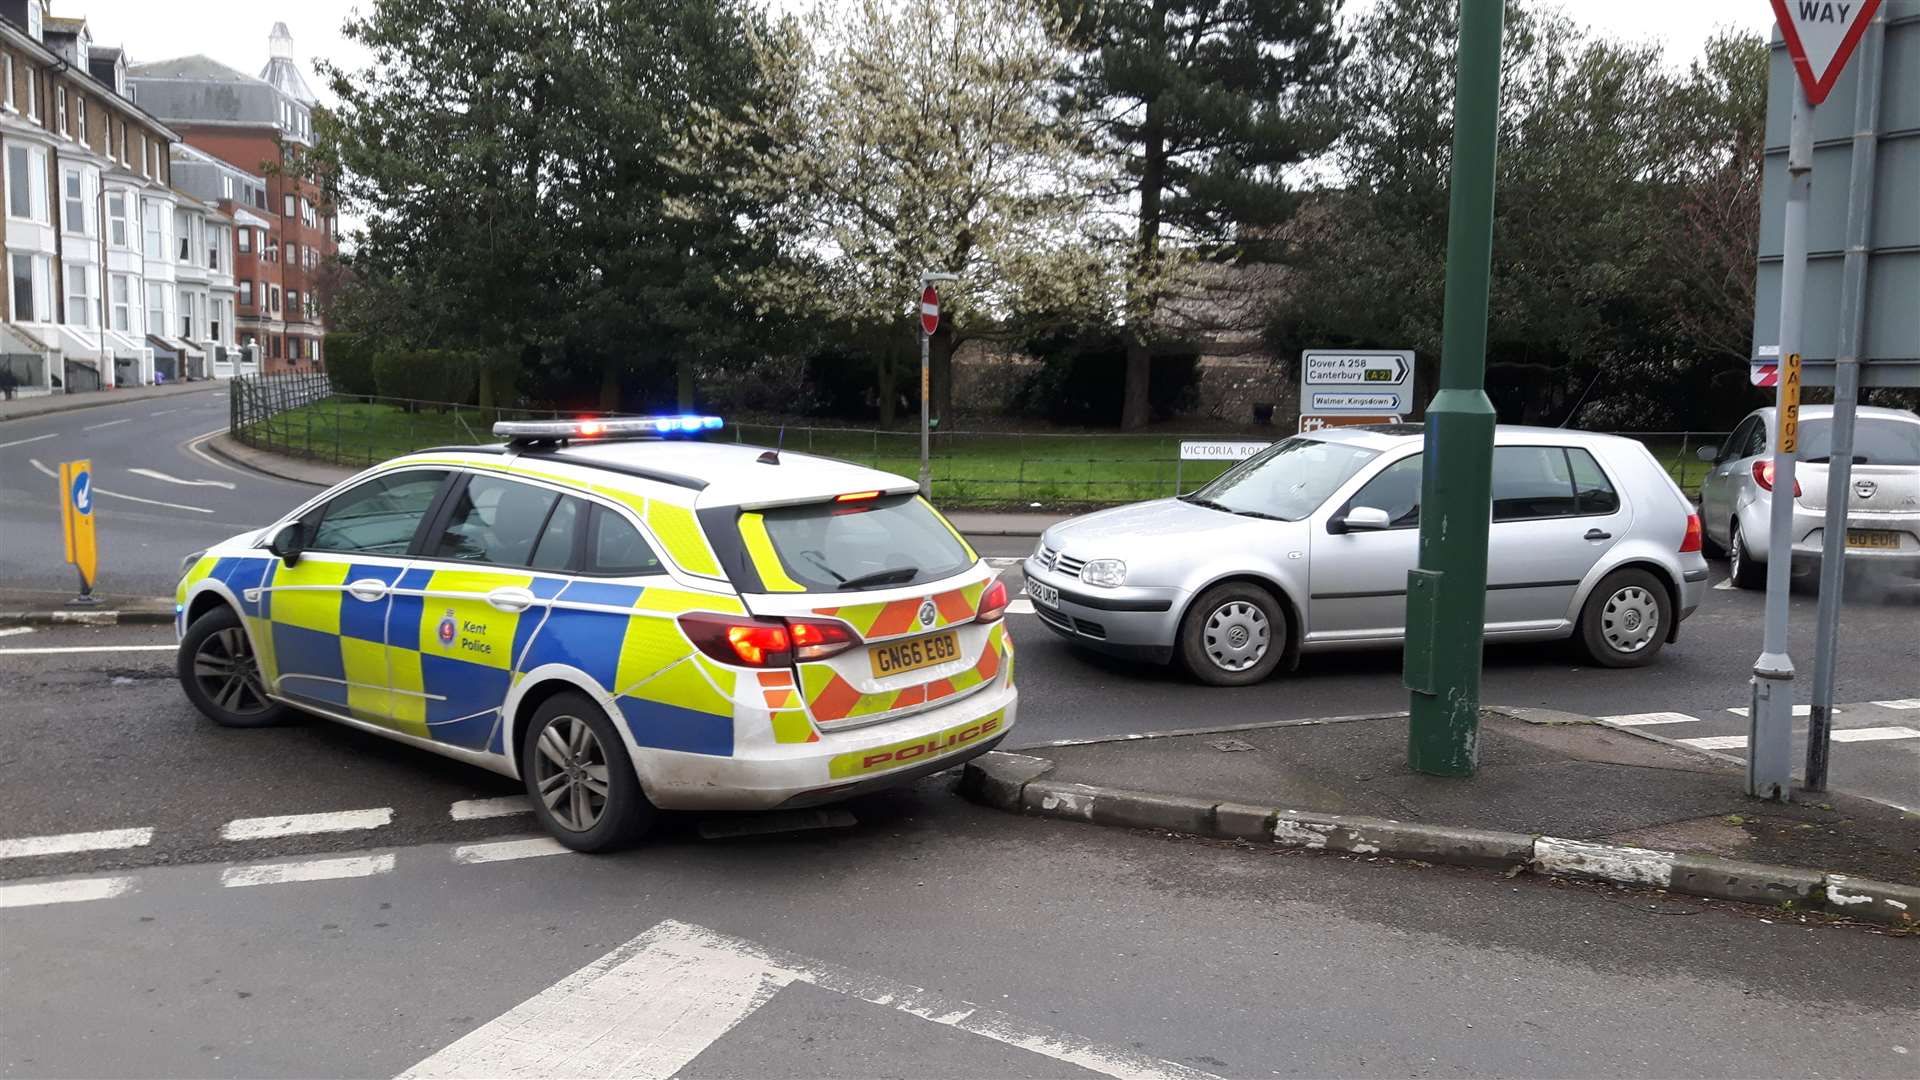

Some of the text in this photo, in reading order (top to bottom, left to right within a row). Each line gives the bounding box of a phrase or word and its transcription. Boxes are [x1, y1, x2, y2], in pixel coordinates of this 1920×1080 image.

[1799, 0, 1851, 24] WAY
[1309, 359, 1367, 369] Dover A 258
[1309, 370, 1362, 381] Canterbury
[1347, 397, 1389, 408] Kingsdown
[1183, 445, 1234, 456] VICTORIA
[463, 620, 487, 635] Kent
[462, 637, 491, 654] Police
[877, 643, 923, 672] GN66
[863, 718, 998, 769] POLICE
